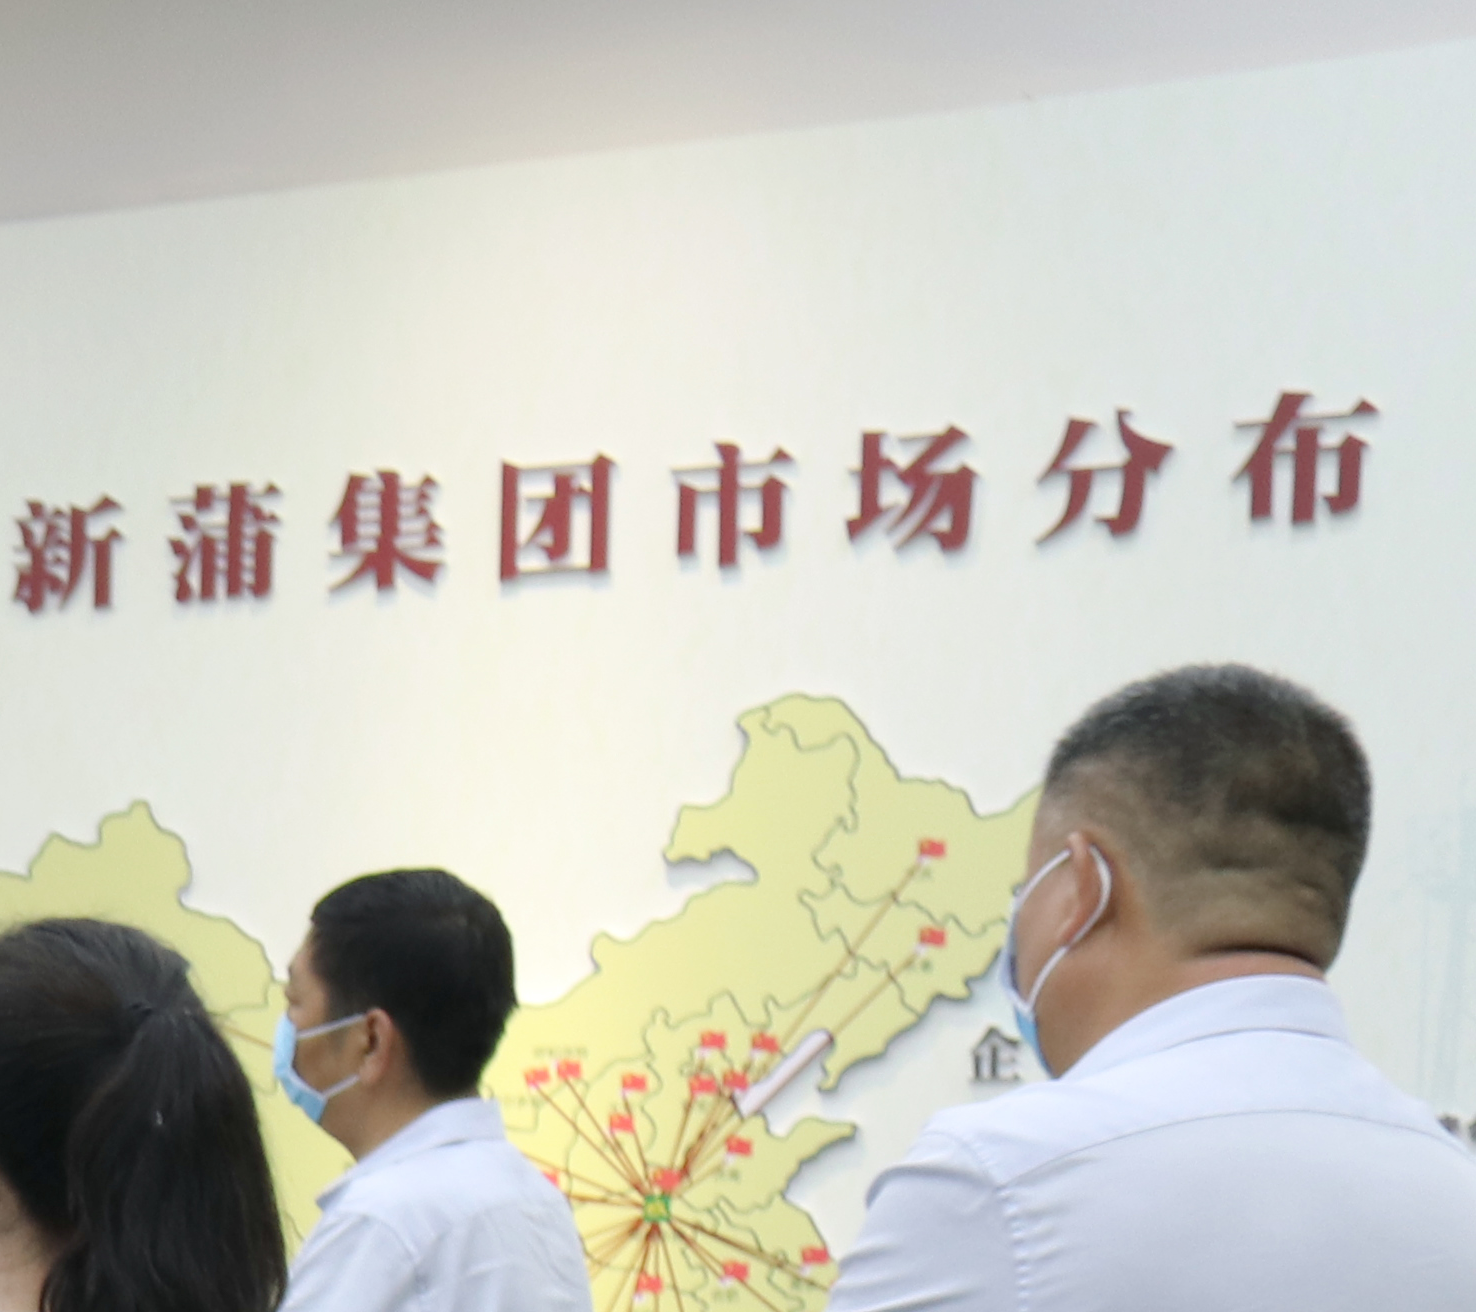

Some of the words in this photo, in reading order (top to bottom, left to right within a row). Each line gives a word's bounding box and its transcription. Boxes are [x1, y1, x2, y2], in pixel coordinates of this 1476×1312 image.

[11, 392, 1380, 613] 新蒲集团市场分布
